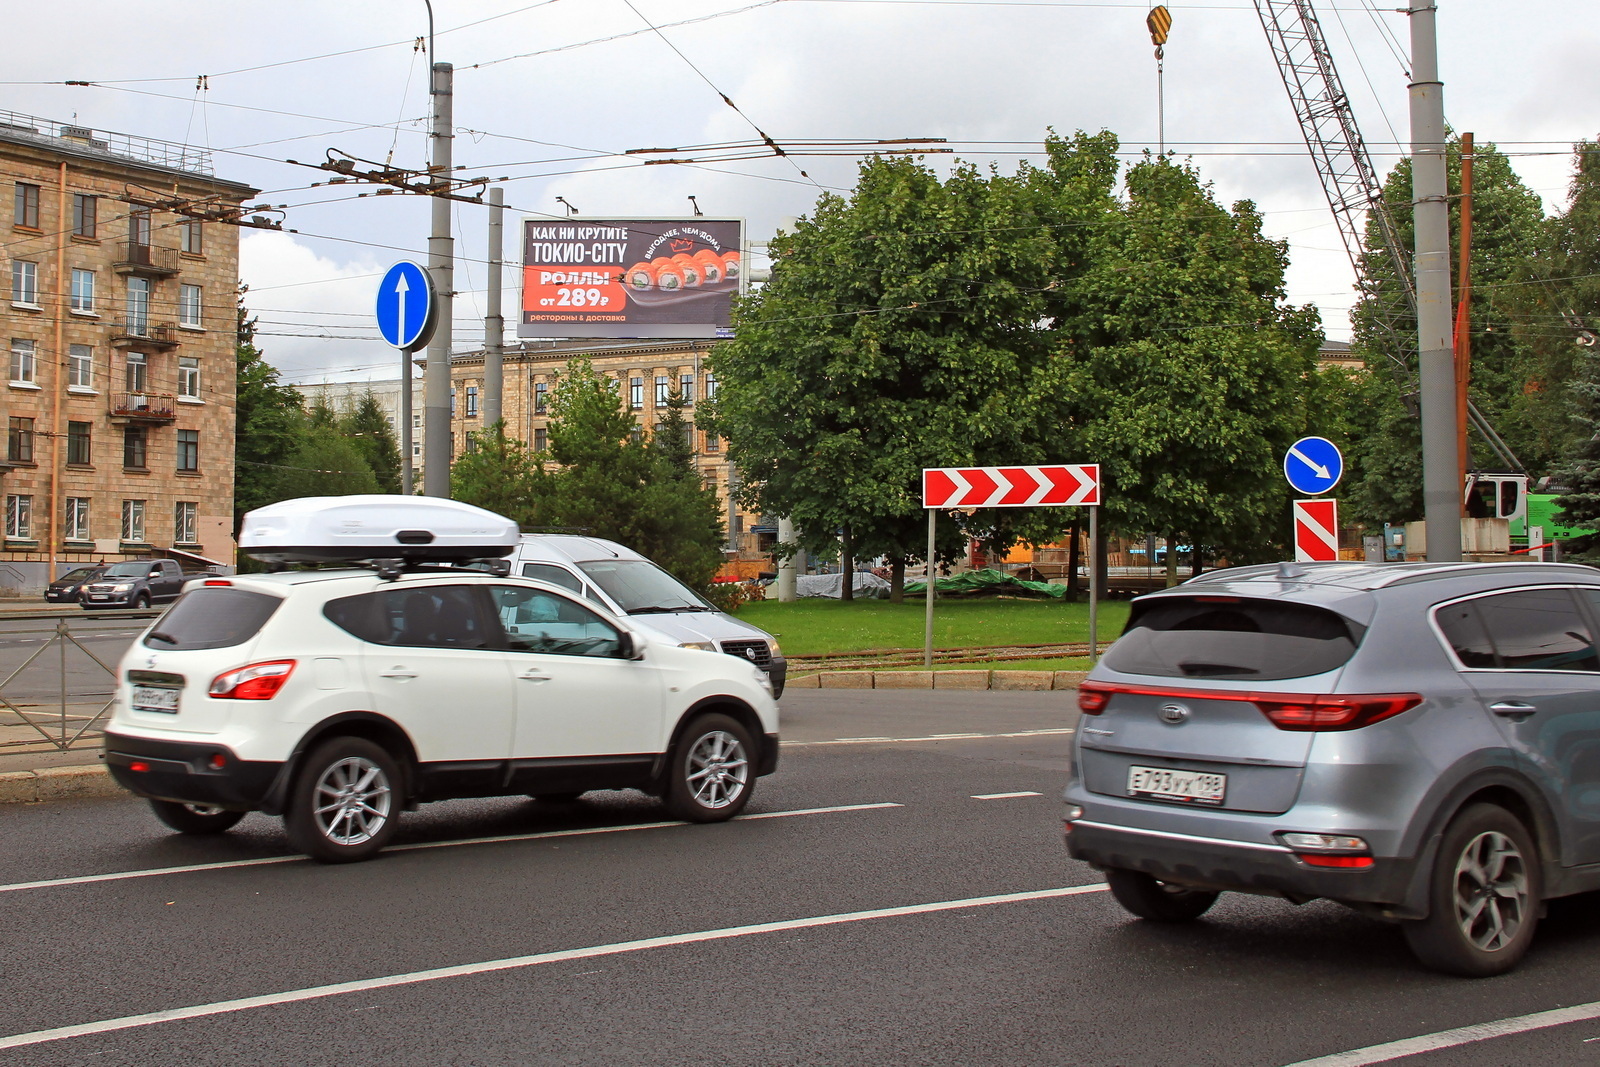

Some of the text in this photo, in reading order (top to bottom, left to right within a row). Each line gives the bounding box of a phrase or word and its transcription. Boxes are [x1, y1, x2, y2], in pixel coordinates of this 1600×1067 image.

[533, 227, 628, 240] КАК НИ КРУТИТЕ
[644, 227, 721, 260] ВЫГОДНЕЕ, ЧЕМ ДОМА
[532, 242, 628, 263] ТОКИО-CITY
[540, 271, 609, 286] РОЛЛЫ
[540, 298, 555, 306] от
[530, 314, 578, 323] рестораны
[585, 314, 626, 322] доставка
